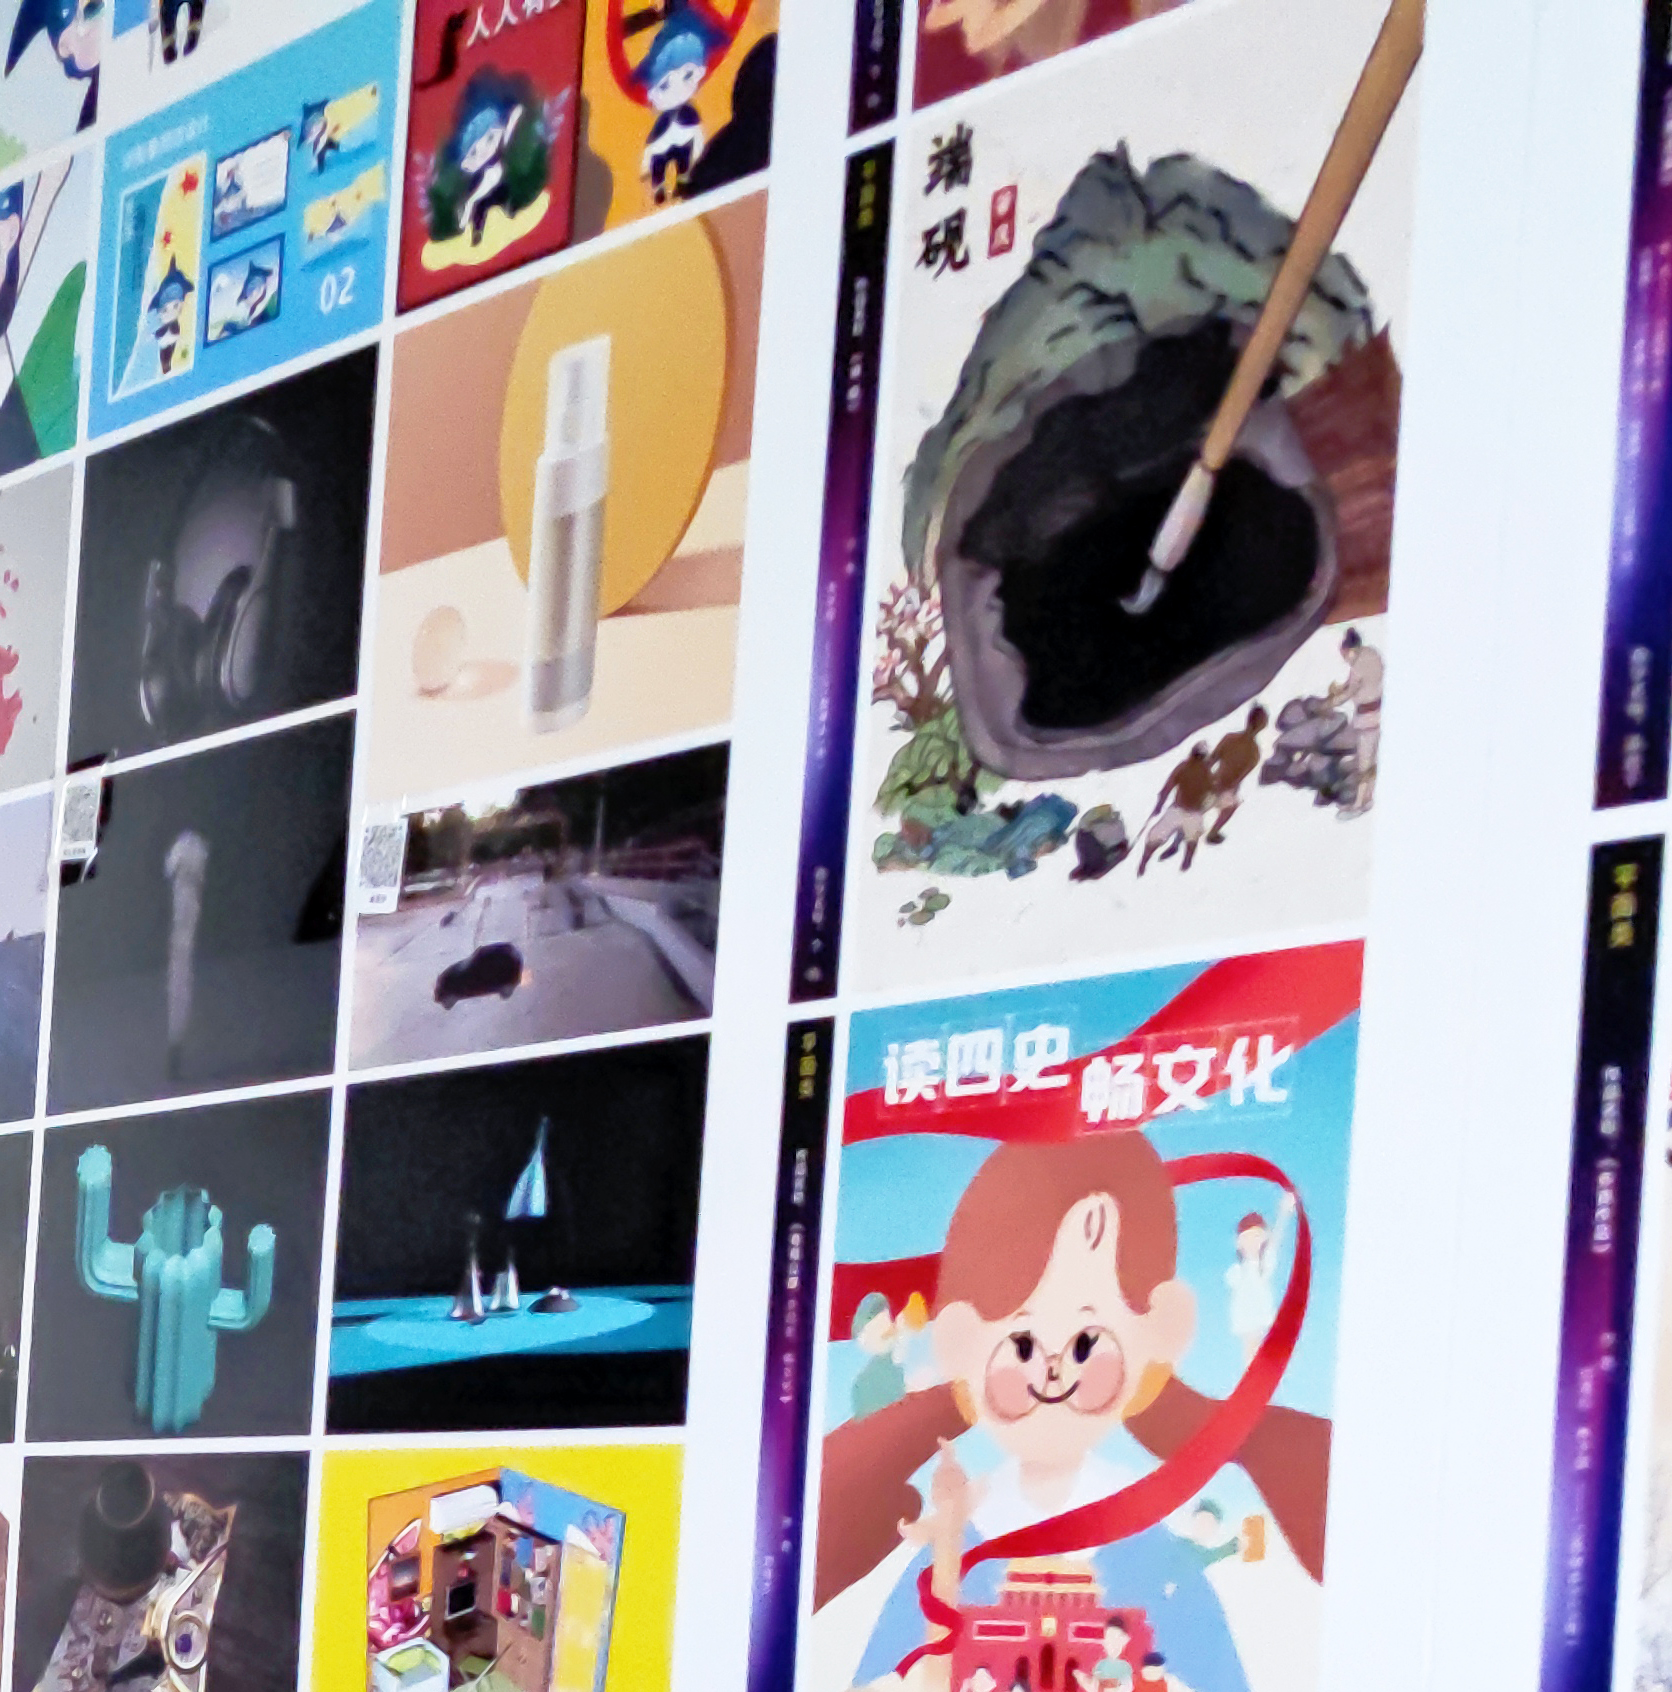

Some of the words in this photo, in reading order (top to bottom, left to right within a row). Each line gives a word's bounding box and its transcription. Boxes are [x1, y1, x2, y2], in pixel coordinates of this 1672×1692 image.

[915, 121, 974, 282] 端砚
[319, 266, 356, 314] 02
[883, 1024, 1070, 1106] 读四史
[1081, 1034, 1294, 1122] 畅文化
